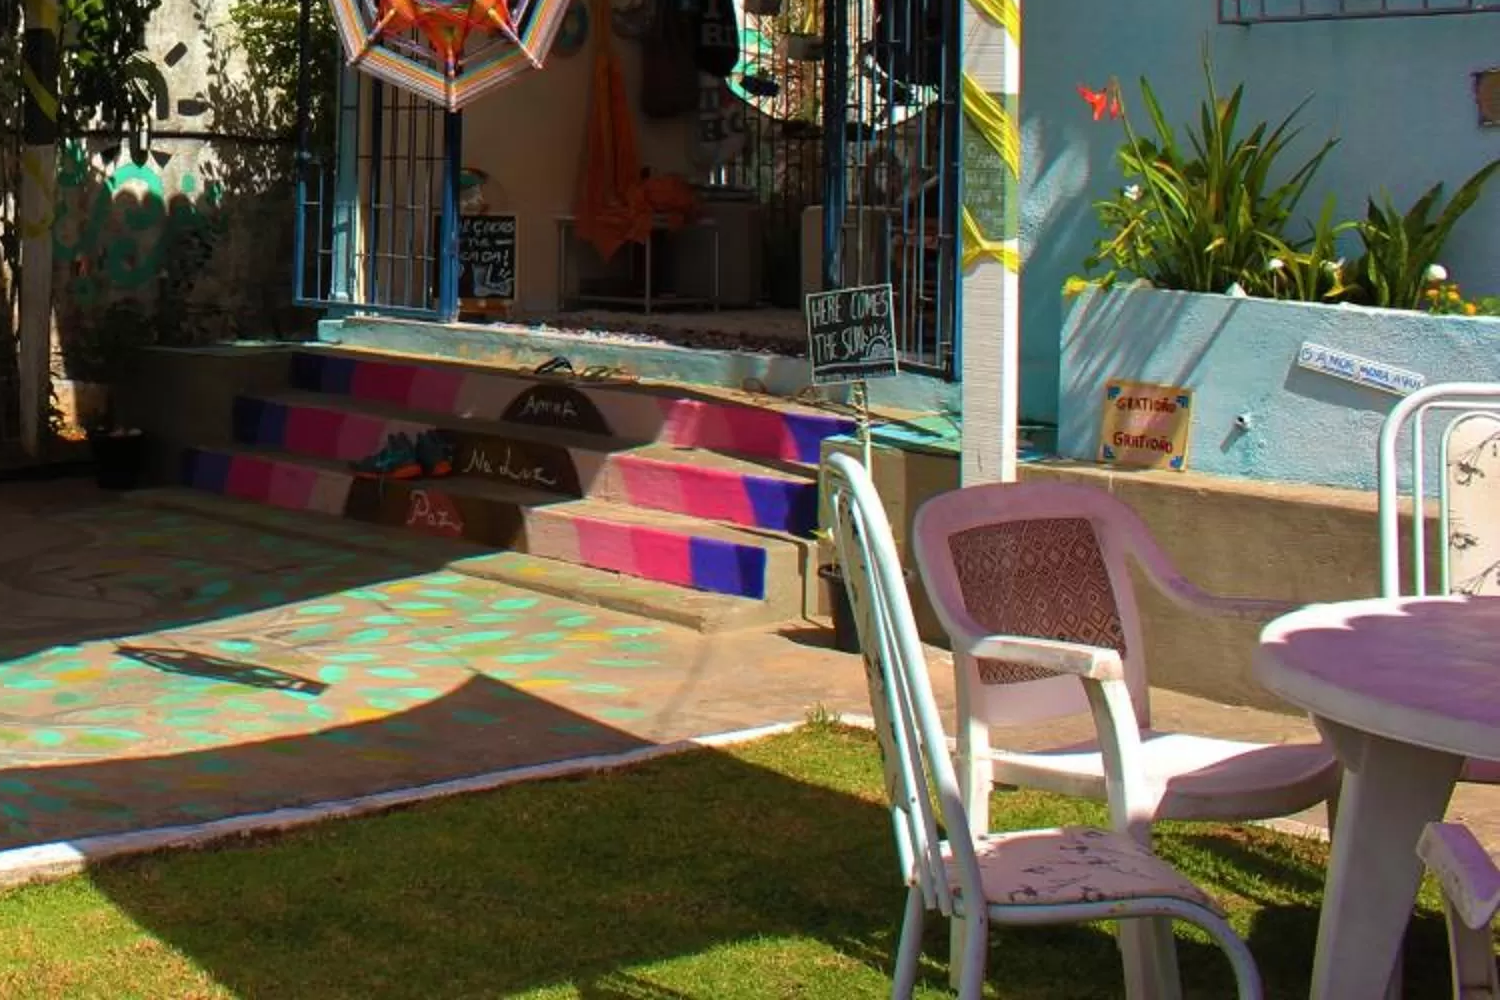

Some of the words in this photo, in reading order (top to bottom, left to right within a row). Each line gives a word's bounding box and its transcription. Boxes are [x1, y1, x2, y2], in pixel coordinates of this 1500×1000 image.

[811, 292, 844, 329] HERE
[849, 288, 889, 321] COMES
[814, 331, 837, 364] THE
[841, 325, 867, 360] SUN
